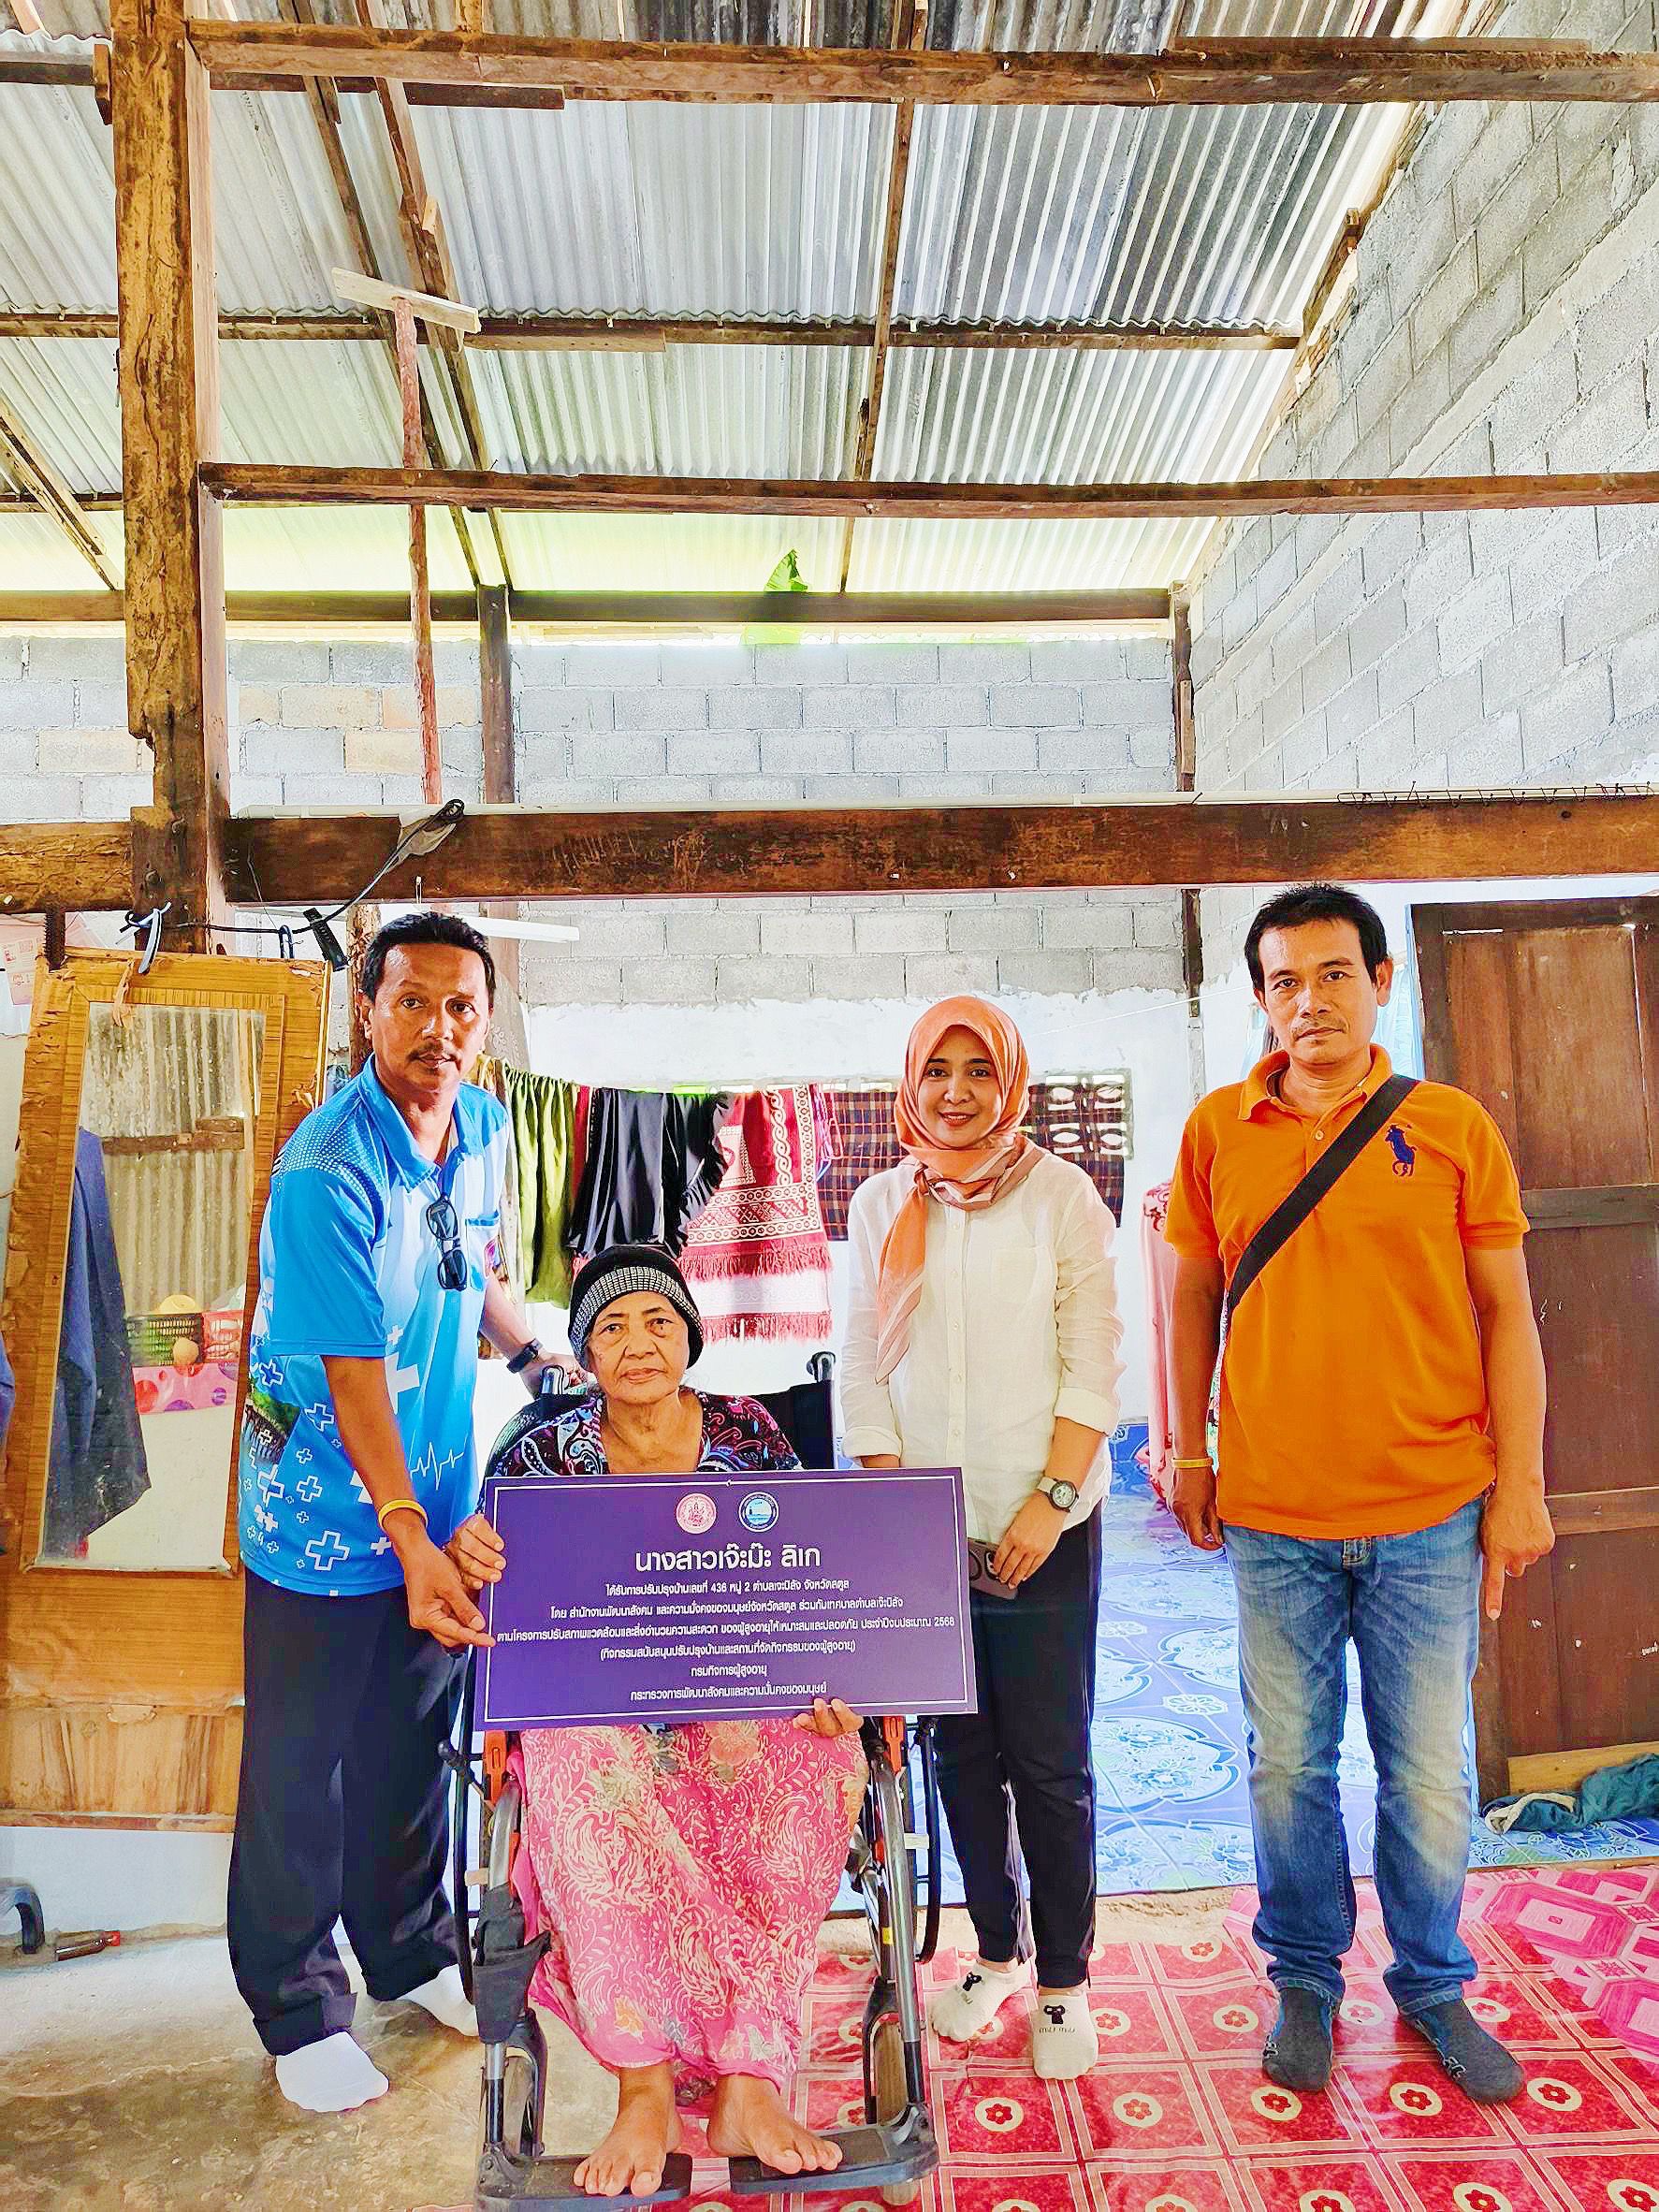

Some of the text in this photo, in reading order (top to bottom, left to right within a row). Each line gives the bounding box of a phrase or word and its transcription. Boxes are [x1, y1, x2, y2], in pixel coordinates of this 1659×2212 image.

[780, 1544, 821, 1567] ลิเก
[710, 1581, 727, 1594] 436
[729, 1580, 742, 1595] หมู่
[744, 1581, 750, 1593] 2
[803, 1578, 850, 1592] จังหวัดสตูล
[550, 1606, 567, 1619] โดย
[934, 1616, 955, 1627] 2568
[691, 1663, 767, 1678] กรมกิจการผู้สูงอายุ
